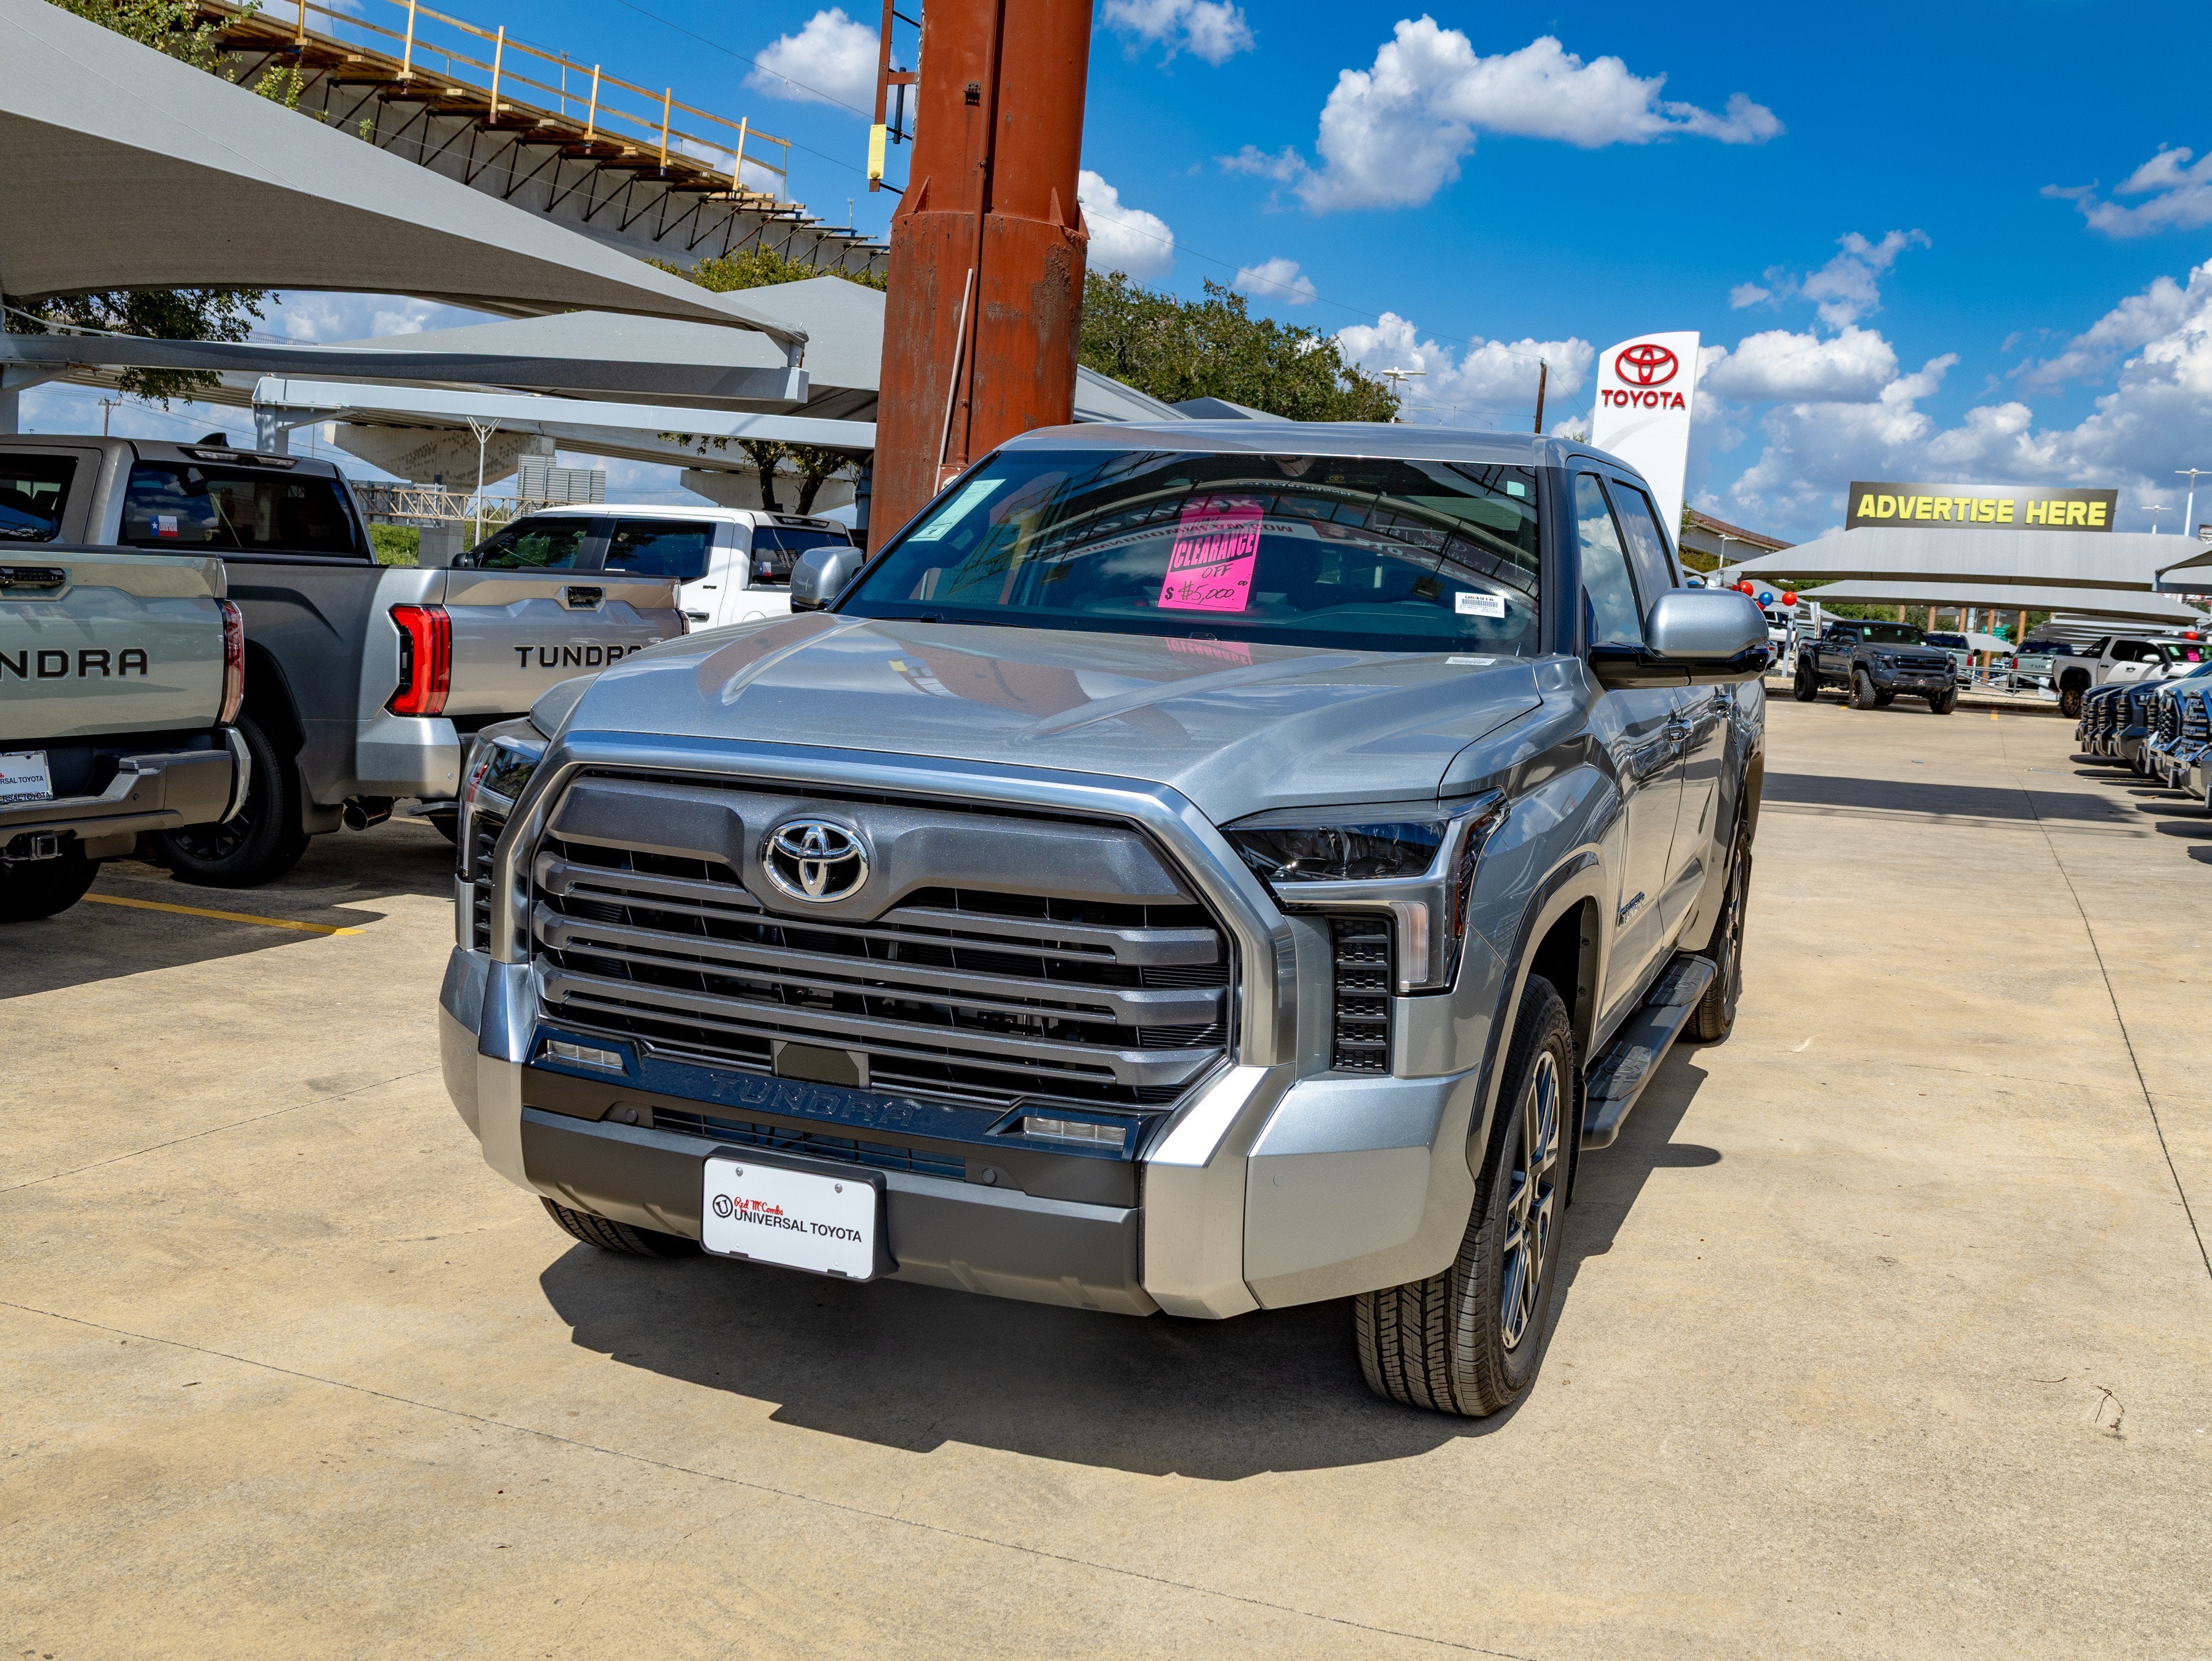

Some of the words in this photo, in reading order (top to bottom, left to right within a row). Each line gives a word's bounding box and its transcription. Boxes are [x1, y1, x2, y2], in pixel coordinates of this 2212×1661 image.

[1601, 389, 1685, 408] TOYOTA
[1857, 494, 2015, 523] ADVERTISE
[2025, 500, 2107, 527] HERE
[1174, 525, 1256, 568] CLEARANCE
[1201, 563, 1233, 578] OFF
[0, 648, 148, 680] NDRA
[22, 792, 51, 800] TOYOTA
[710, 1074, 914, 1127] TUNDRA
[734, 1197, 749, 1212] Red
[750, 1200, 783, 1216] McCombs
[734, 1208, 808, 1233] UNIVERSAL
[810, 1222, 862, 1243] TOYOTA
